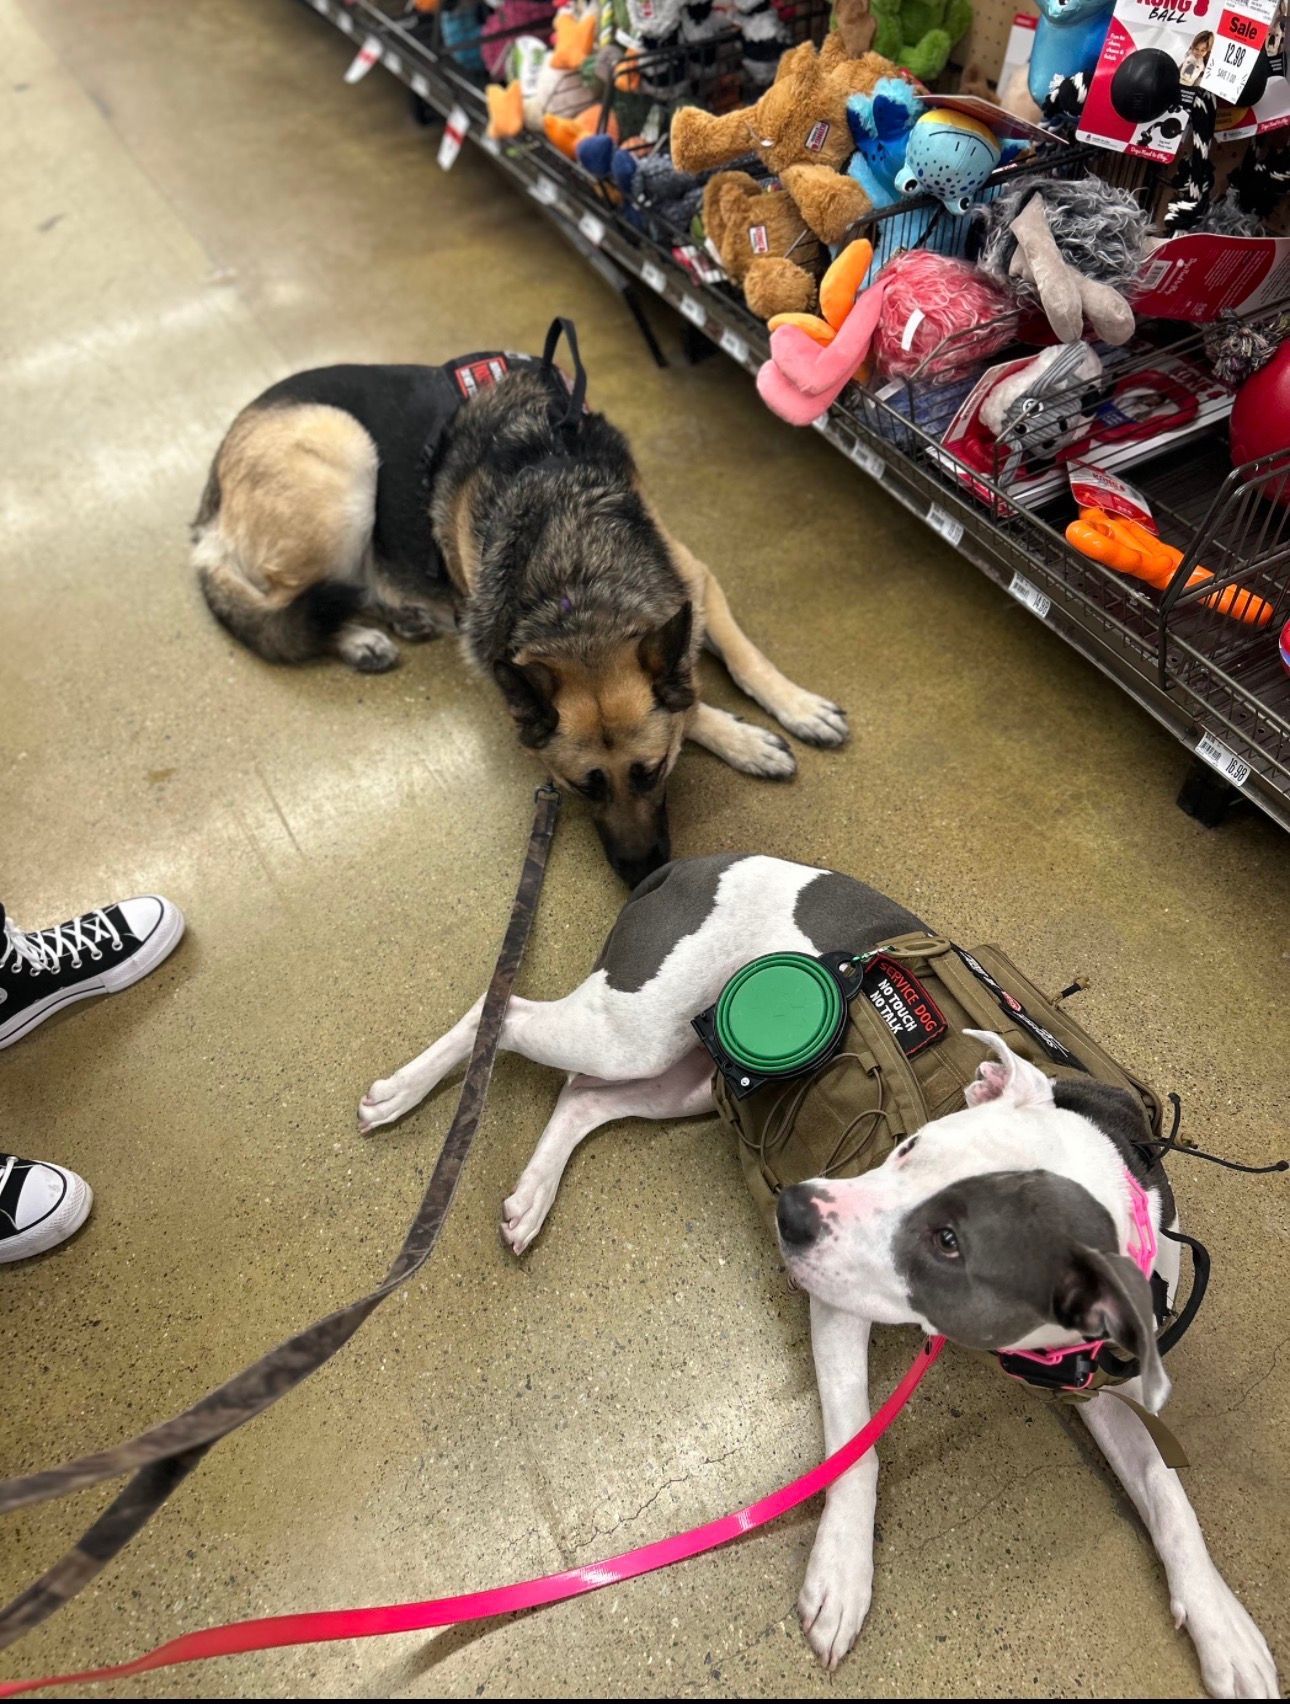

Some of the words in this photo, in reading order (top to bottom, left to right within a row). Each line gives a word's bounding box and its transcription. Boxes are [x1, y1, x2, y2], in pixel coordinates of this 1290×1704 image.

[1148, 7, 1187, 23] BALL
[1229, 17, 1258, 40] Sale
[1223, 42, 1247, 68] 12.98
[1226, 758, 1247, 781] 16.98
[878, 979, 894, 995] NO
[889, 994, 917, 1031] TOUCH
[880, 963, 919, 1006] SERVICE
[914, 1004, 938, 1032] DOG
[870, 991, 885, 1007] NO
[880, 1005, 904, 1034] TALK
